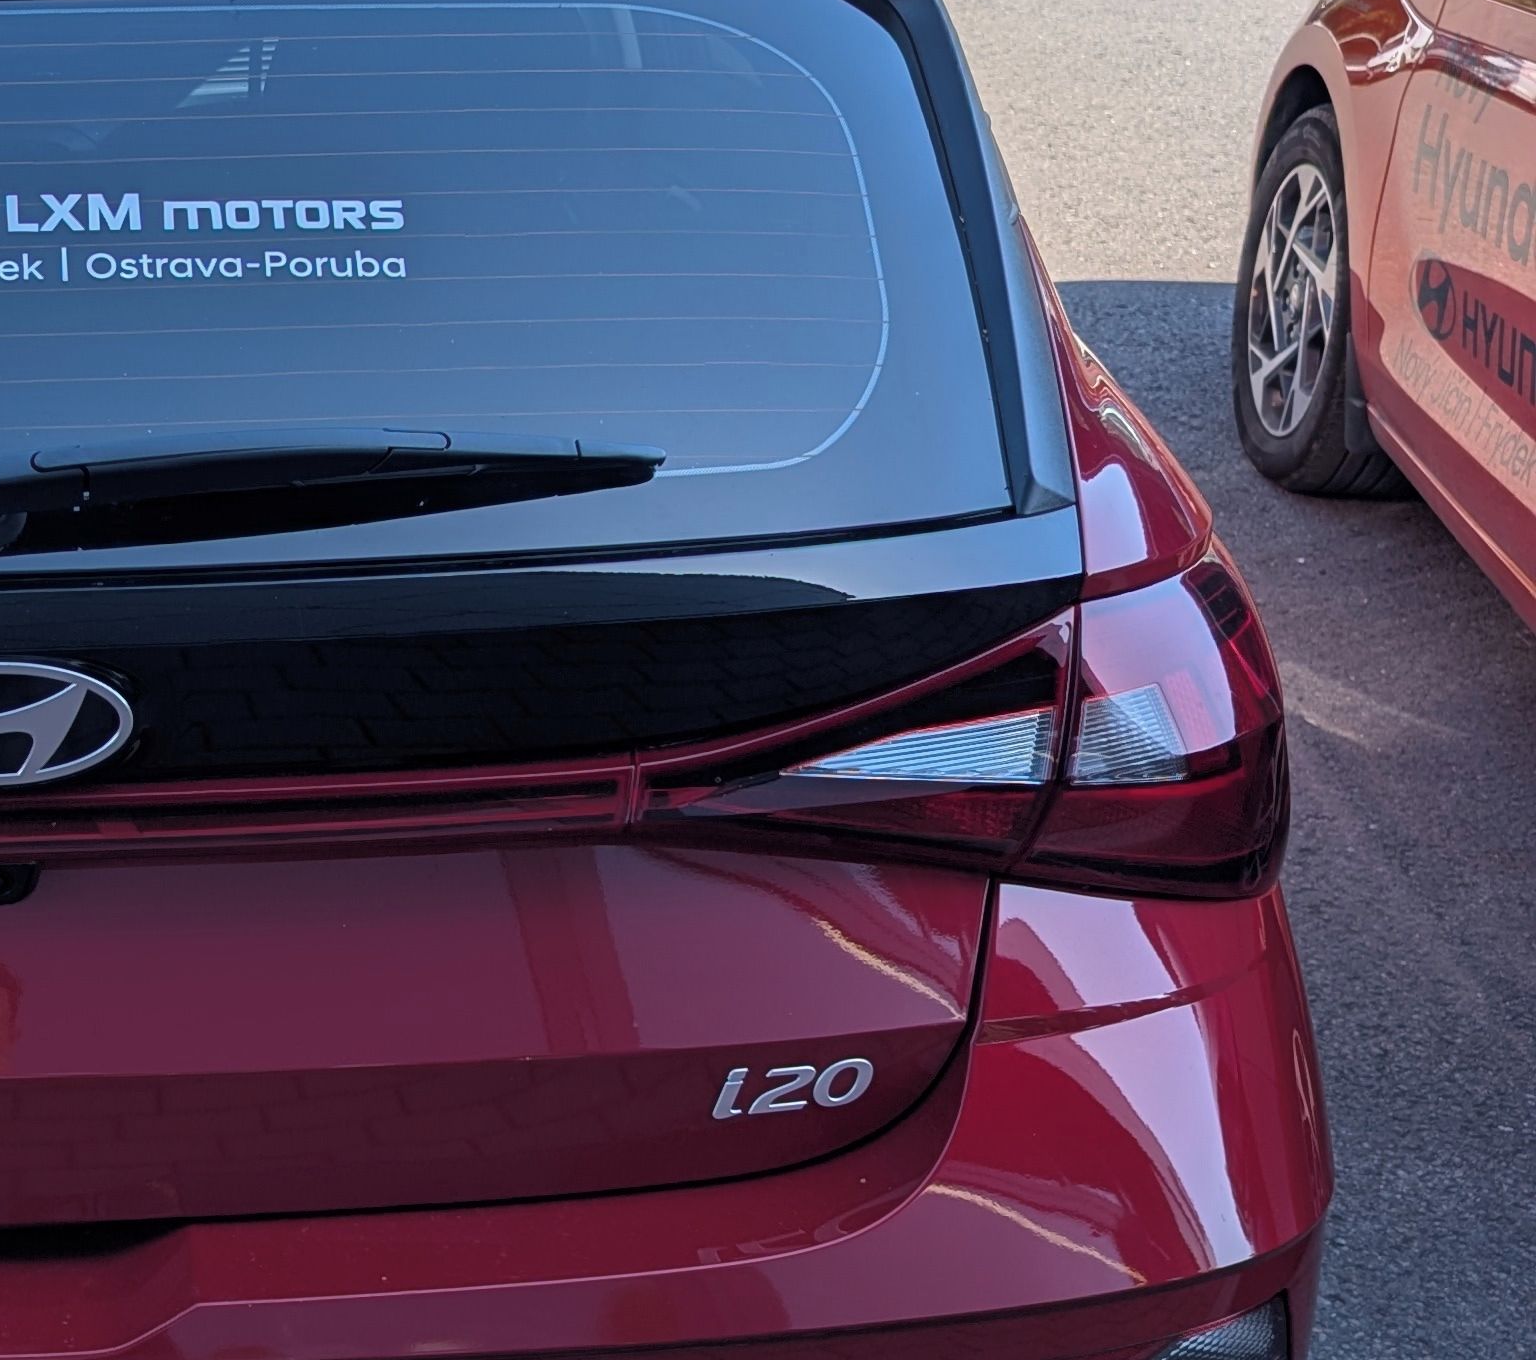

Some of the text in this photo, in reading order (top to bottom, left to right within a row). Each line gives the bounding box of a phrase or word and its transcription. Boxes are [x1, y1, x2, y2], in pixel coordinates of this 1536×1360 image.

[5, 192, 142, 233] LXM
[86, 250, 407, 280] Ostrava-Poruba
[712, 1057, 874, 1120] i20
